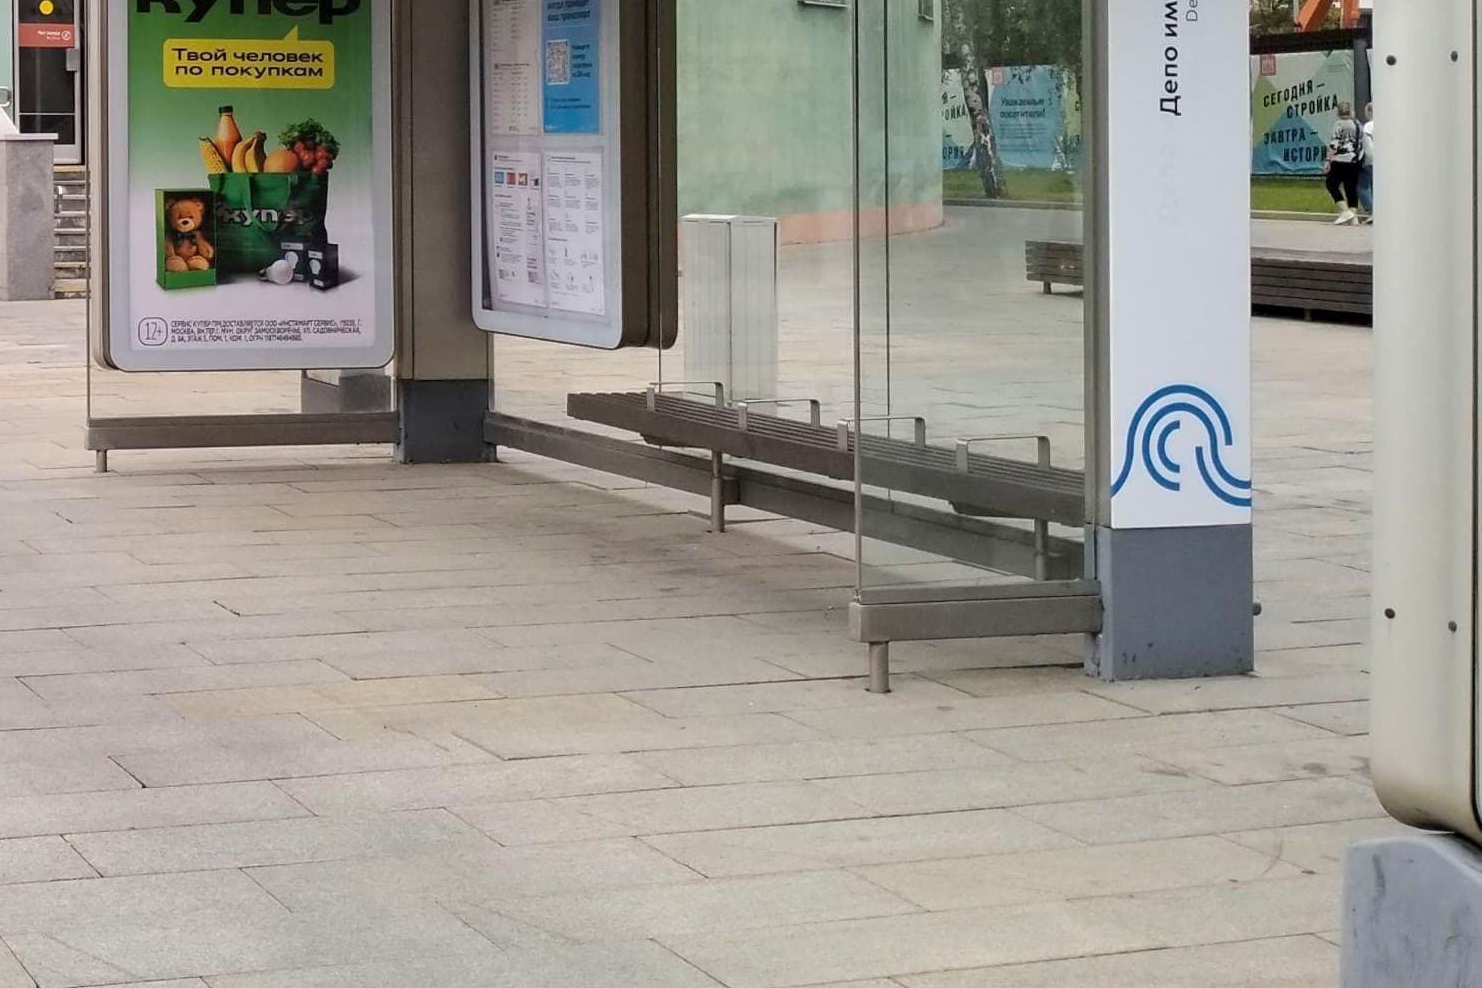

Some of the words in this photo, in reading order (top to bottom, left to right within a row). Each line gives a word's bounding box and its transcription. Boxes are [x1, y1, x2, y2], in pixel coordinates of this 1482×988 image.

[171, 47, 227, 63] Твой
[233, 51, 324, 63] человек
[175, 65, 204, 77] по
[211, 65, 324, 80] покупкам
[1159, 46, 1182, 117] Депо
[1263, 79, 1314, 109] СЕГОДНЯ
[1286, 94, 1339, 119] СТРОЙКА
[1263, 127, 1307, 145] ЗАВТРА
[1283, 145, 1328, 163] ИСТОРИ
[144, 321, 162, 341] 12+
